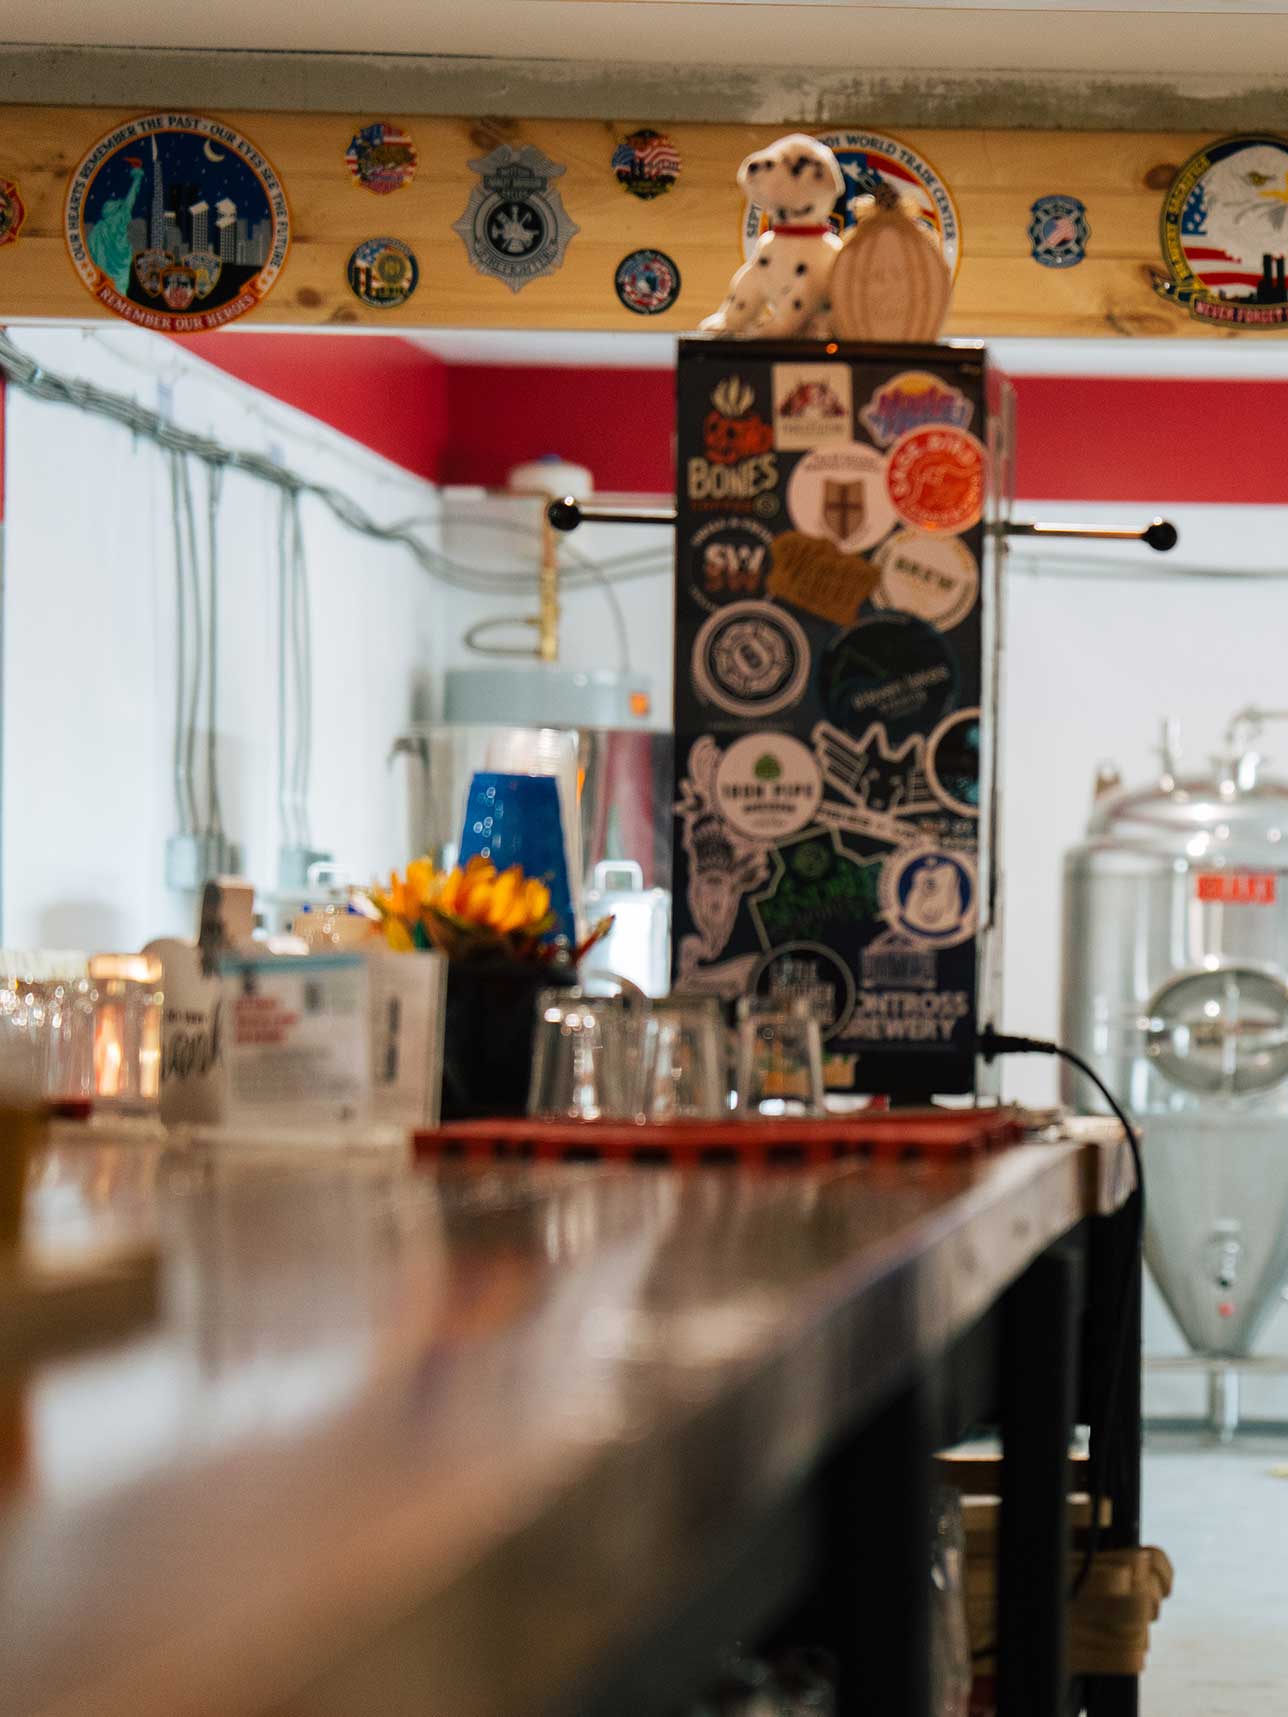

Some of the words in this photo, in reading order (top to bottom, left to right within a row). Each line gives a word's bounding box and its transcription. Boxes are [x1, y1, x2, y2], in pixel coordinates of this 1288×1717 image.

[137, 117, 162, 131] THE
[167, 114, 200, 129] PAST
[209, 124, 237, 143] OUR
[80, 124, 136, 179] REMEMBER
[237, 140, 265, 168] EYES
[261, 167, 281, 191] SEE
[746, 203, 761, 239] SEPT
[845, 135, 898, 156] WORLD
[899, 149, 936, 186] TRADE
[932, 186, 957, 241] CENTER
[68, 181, 87, 231] HEARTS
[272, 192, 288, 217] THE
[71, 233, 86, 262] OUR
[270, 221, 288, 268] FUTURE
[100, 286, 172, 329] REMEMBER
[175, 319, 204, 331] OUR
[206, 294, 256, 327] HEROES
[1195, 300, 1233, 320] NEVER
[1238, 306, 1282, 324] FORGET
[687, 453, 780, 500] BONES
